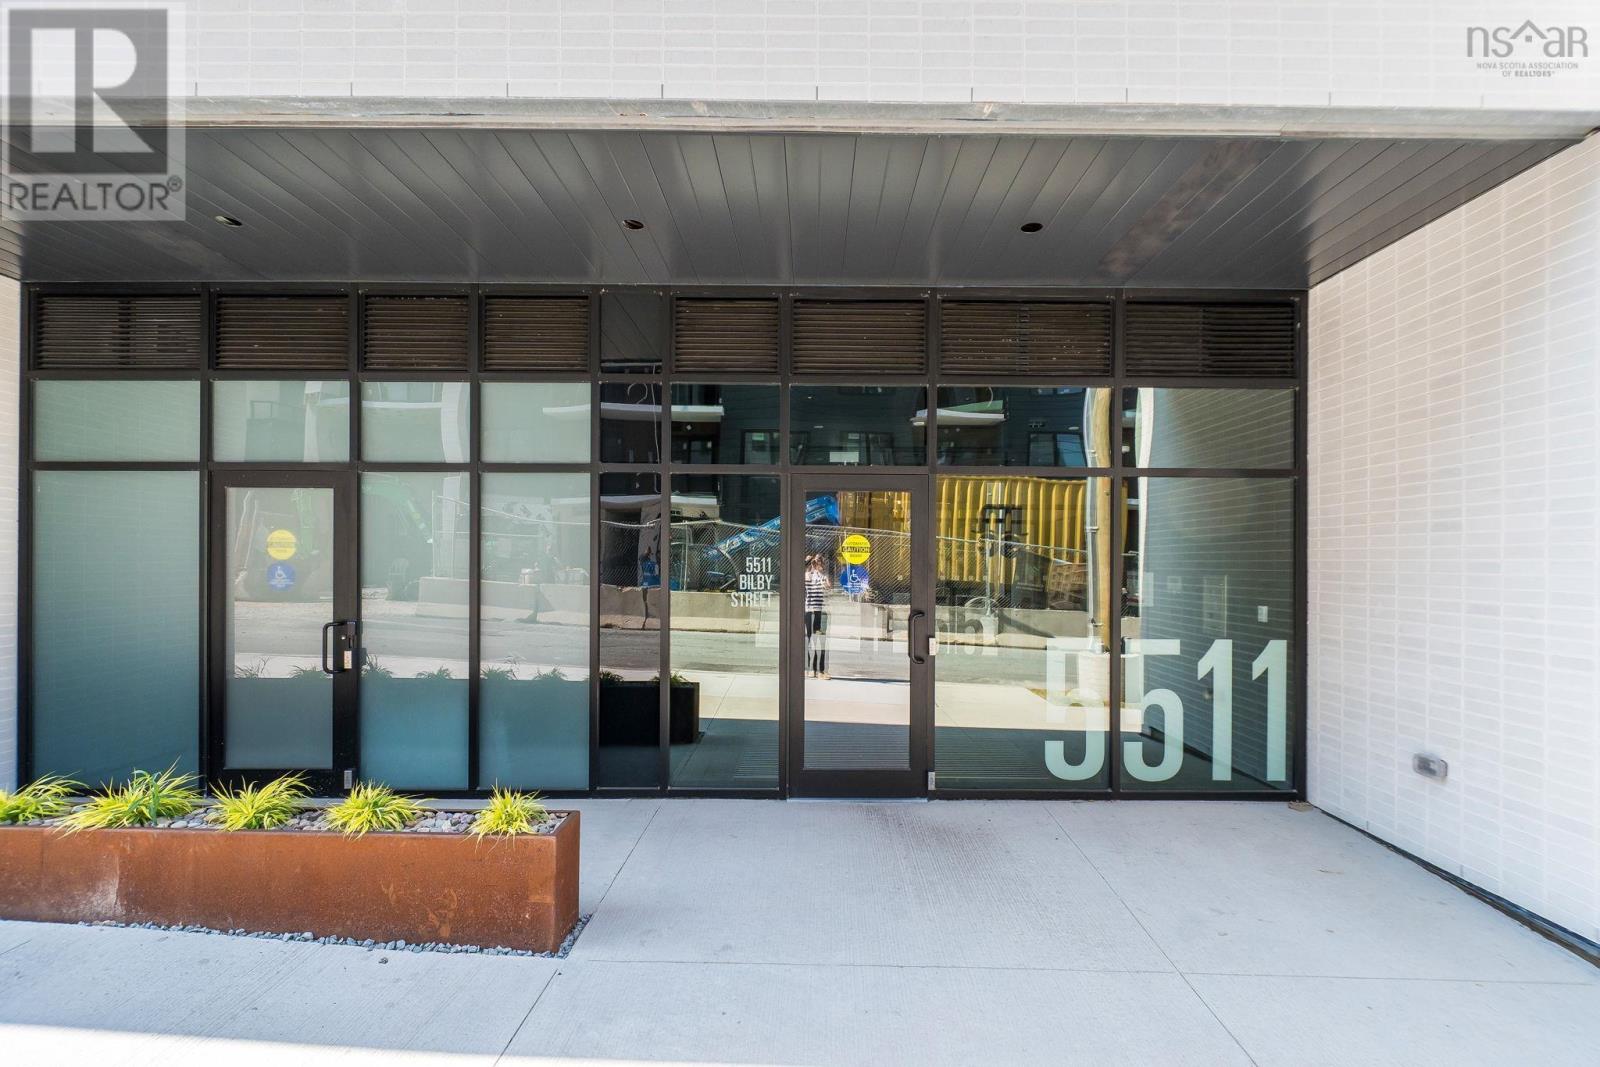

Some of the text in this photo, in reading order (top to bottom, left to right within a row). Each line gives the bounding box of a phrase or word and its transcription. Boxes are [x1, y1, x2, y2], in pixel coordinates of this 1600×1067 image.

[745, 557, 772, 573] 5511
[739, 574, 773, 590] BILBY
[731, 591, 773, 608] STREET
[1044, 636, 1288, 782] 5511
